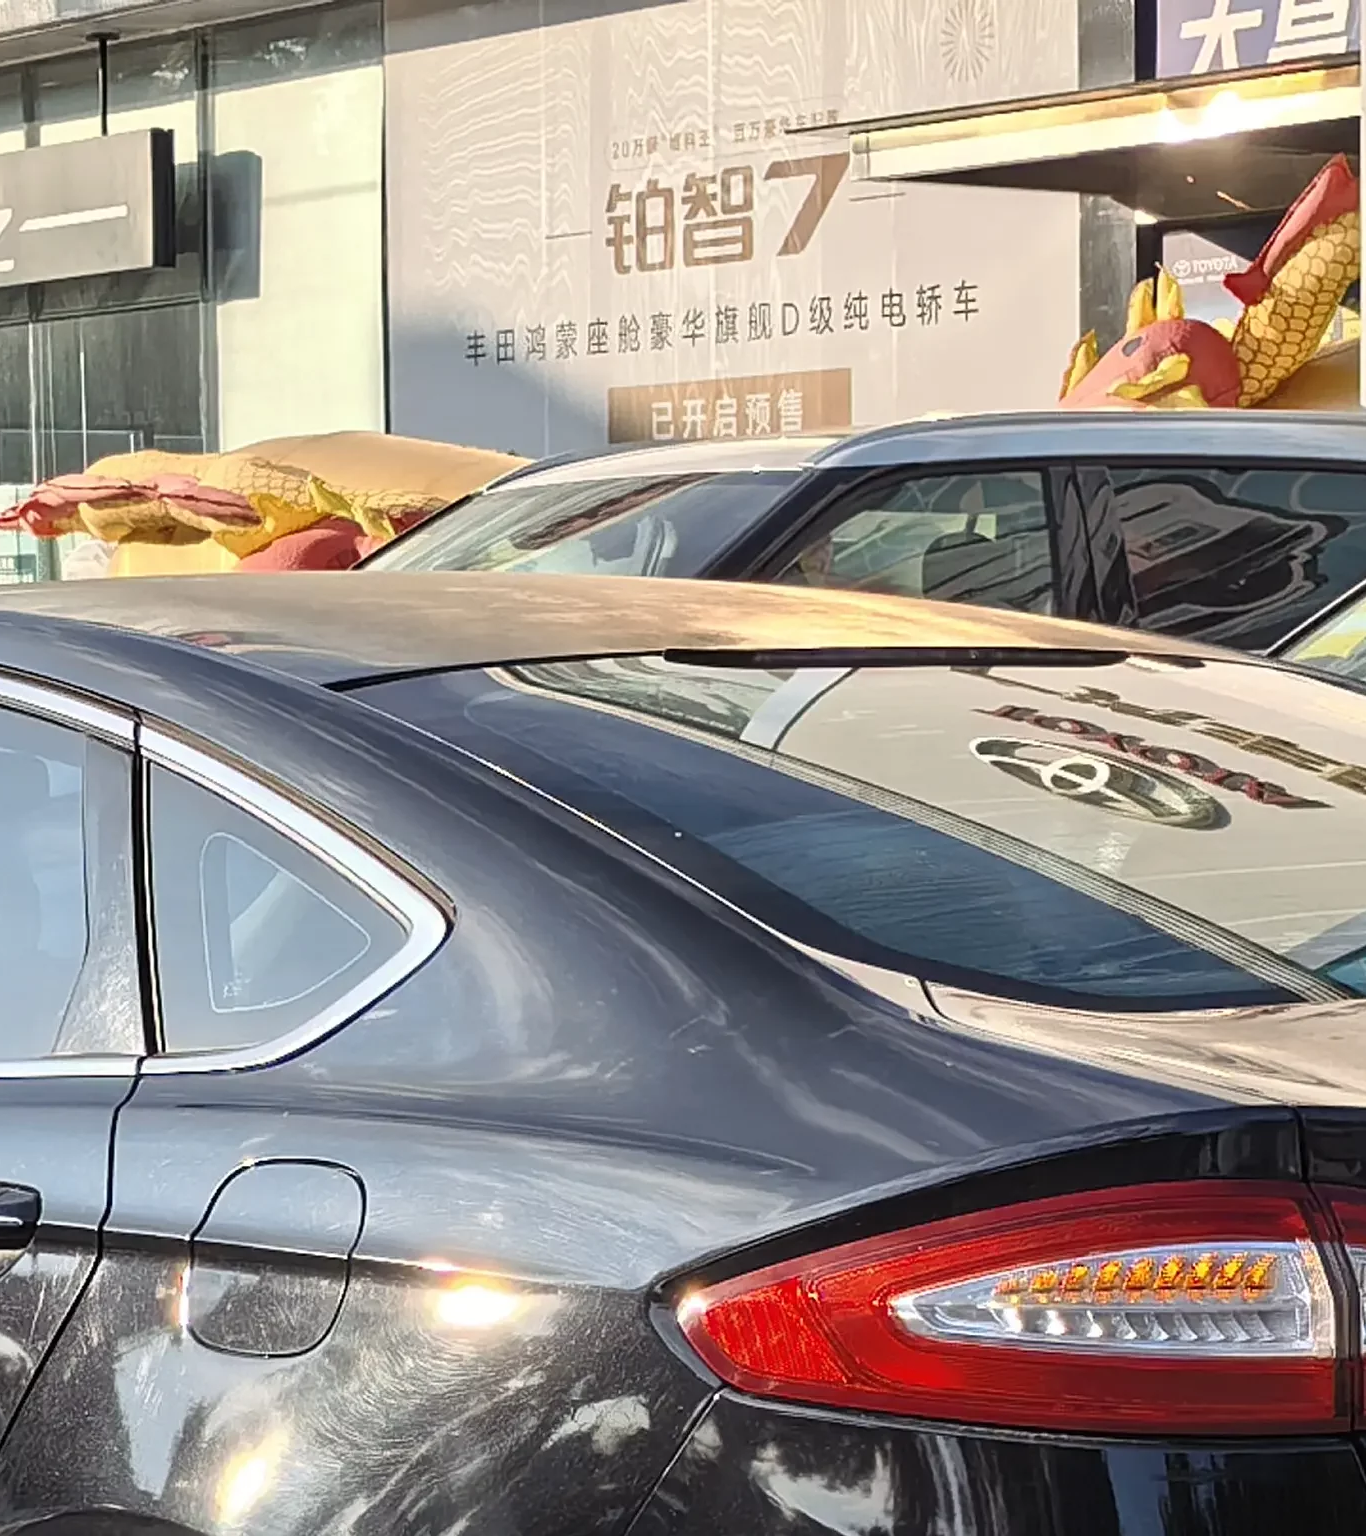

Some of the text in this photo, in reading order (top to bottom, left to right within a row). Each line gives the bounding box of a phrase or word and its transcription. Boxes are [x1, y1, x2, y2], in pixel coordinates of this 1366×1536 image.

[605, 151, 850, 275] 铂智7
[464, 279, 980, 367] 丰田鸿蒙座舱豪华旗舰D级纯电轿车
[651, 388, 805, 441] 已开启预售
